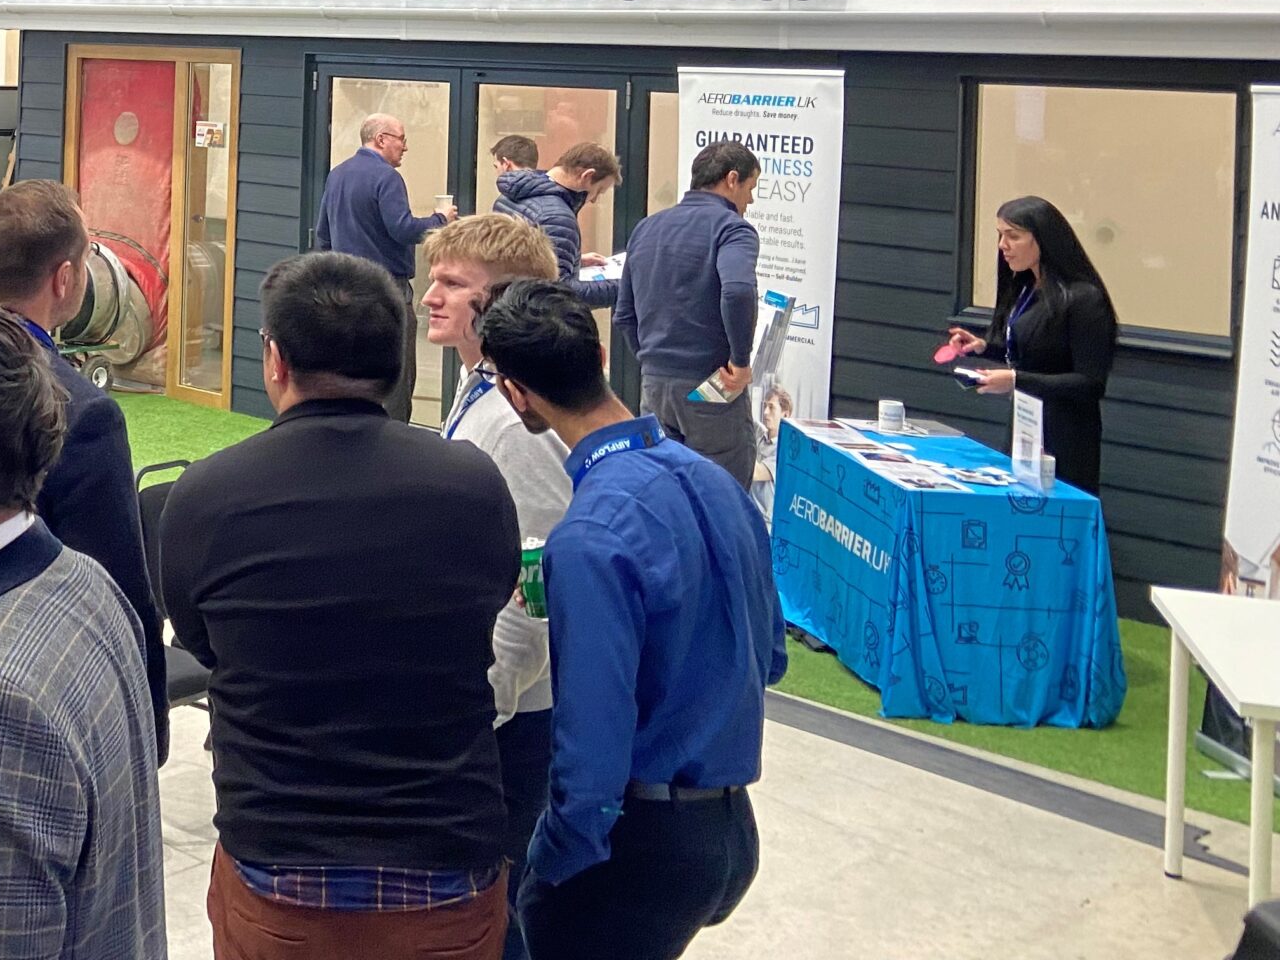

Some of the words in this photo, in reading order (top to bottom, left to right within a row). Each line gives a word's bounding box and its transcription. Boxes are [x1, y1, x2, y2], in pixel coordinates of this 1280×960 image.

[712, 108, 732, 117] Reduce
[696, 131, 814, 155] GUARANTEED
[757, 179, 812, 203] EASY
[766, 214, 778, 222] and
[758, 223, 767, 232] for
[591, 439, 631, 462] AIRFLOW
